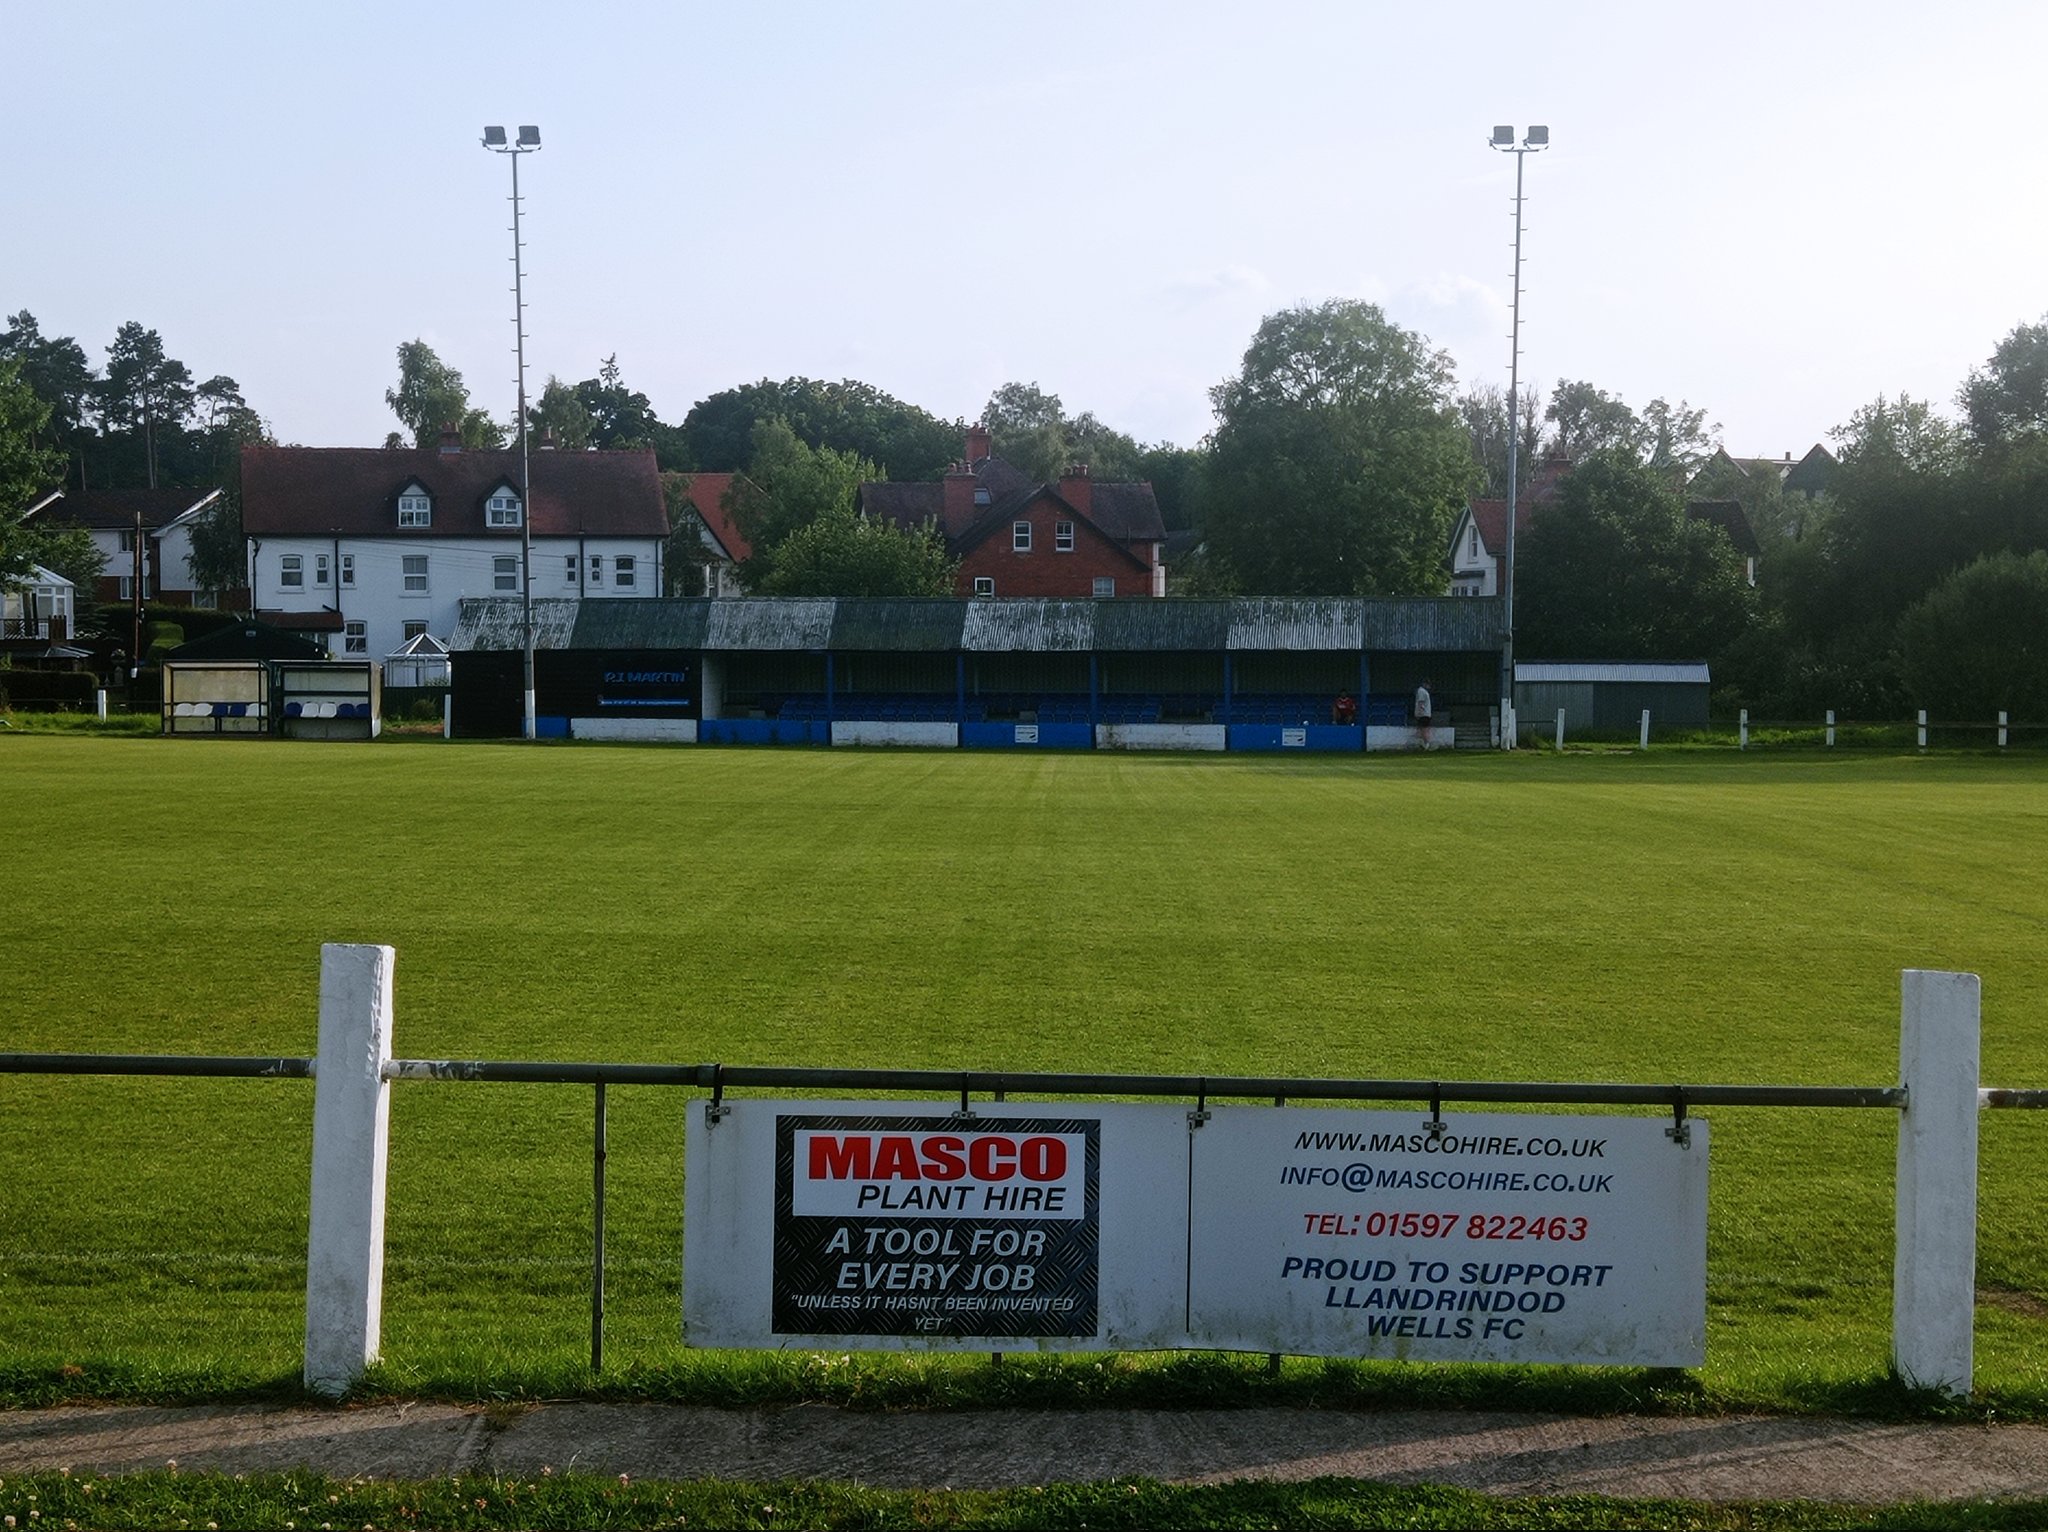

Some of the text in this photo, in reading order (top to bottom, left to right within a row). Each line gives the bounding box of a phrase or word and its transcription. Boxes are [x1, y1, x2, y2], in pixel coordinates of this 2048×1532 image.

[809, 1136, 1066, 1181] MASCO
[1294, 1132, 1607, 1158] WWW.MASCOHIRE.CO.UK
[1280, 1163, 1613, 1194] INFO@MASCOHIRE.CO.UK
[857, 1185, 1066, 1211] PLANT HIRE
[1304, 1213, 1588, 1241] TEL: 01597 822463
[826, 1228, 1046, 1256] A TOOL FOR
[837, 1263, 1035, 1291] EVERY JOB
[1282, 1257, 1612, 1286] PROUD TO SUPPORT
[865, 1296, 878, 1309] IT
[885, 1297, 941, 1309] HASNT
[945, 1298, 987, 1310] BEEN
[992, 1299, 1073, 1311] INVENTED
[1326, 1287, 1565, 1313] LLANDRINDOD
[1367, 1316, 1525, 1340] WELLS FC
